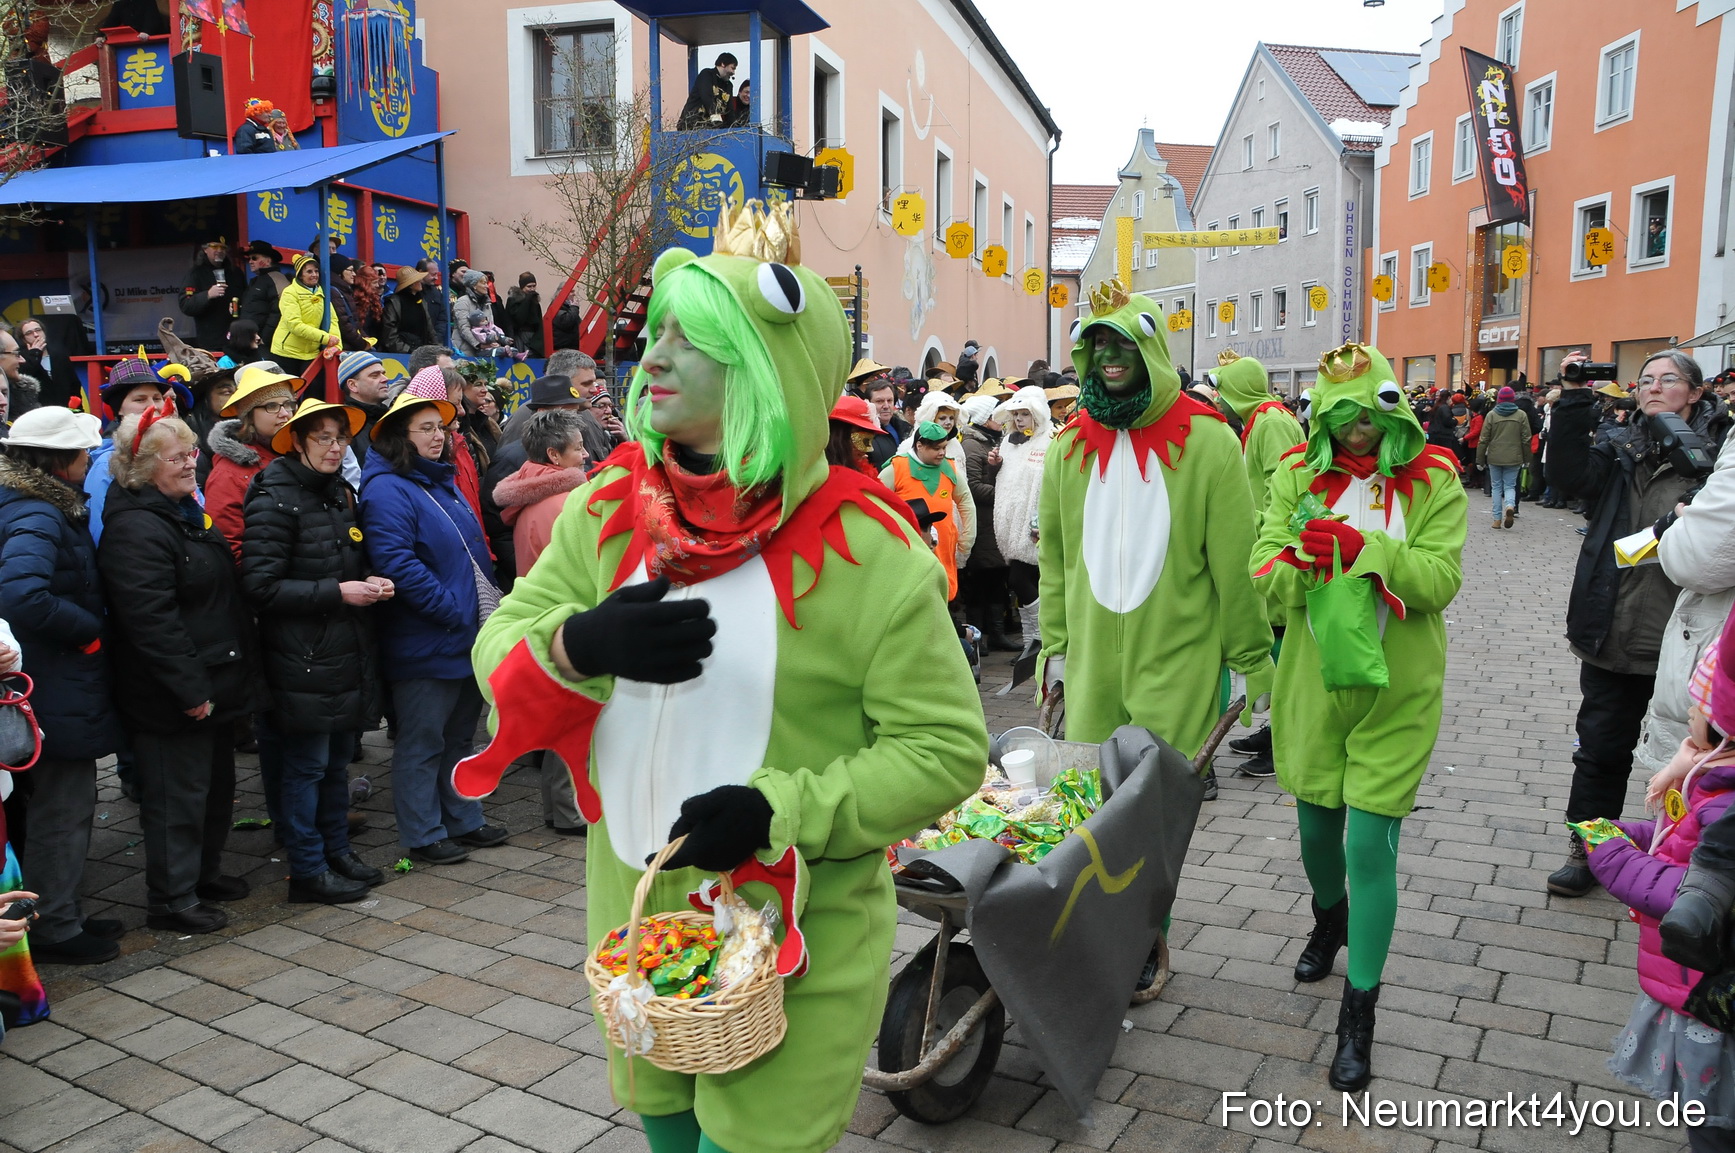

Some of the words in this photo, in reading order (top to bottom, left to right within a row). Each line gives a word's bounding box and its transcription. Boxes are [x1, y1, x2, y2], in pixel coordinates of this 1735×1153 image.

[1345, 202, 1354, 258] UHREN
[115, 288, 125, 296] DJ
[127, 287, 148, 296] Mike
[1342, 266, 1353, 345] SCHMUCK
[1478, 326, 1520, 344] GÖTZ
[1256, 337, 1286, 359] OEXL
